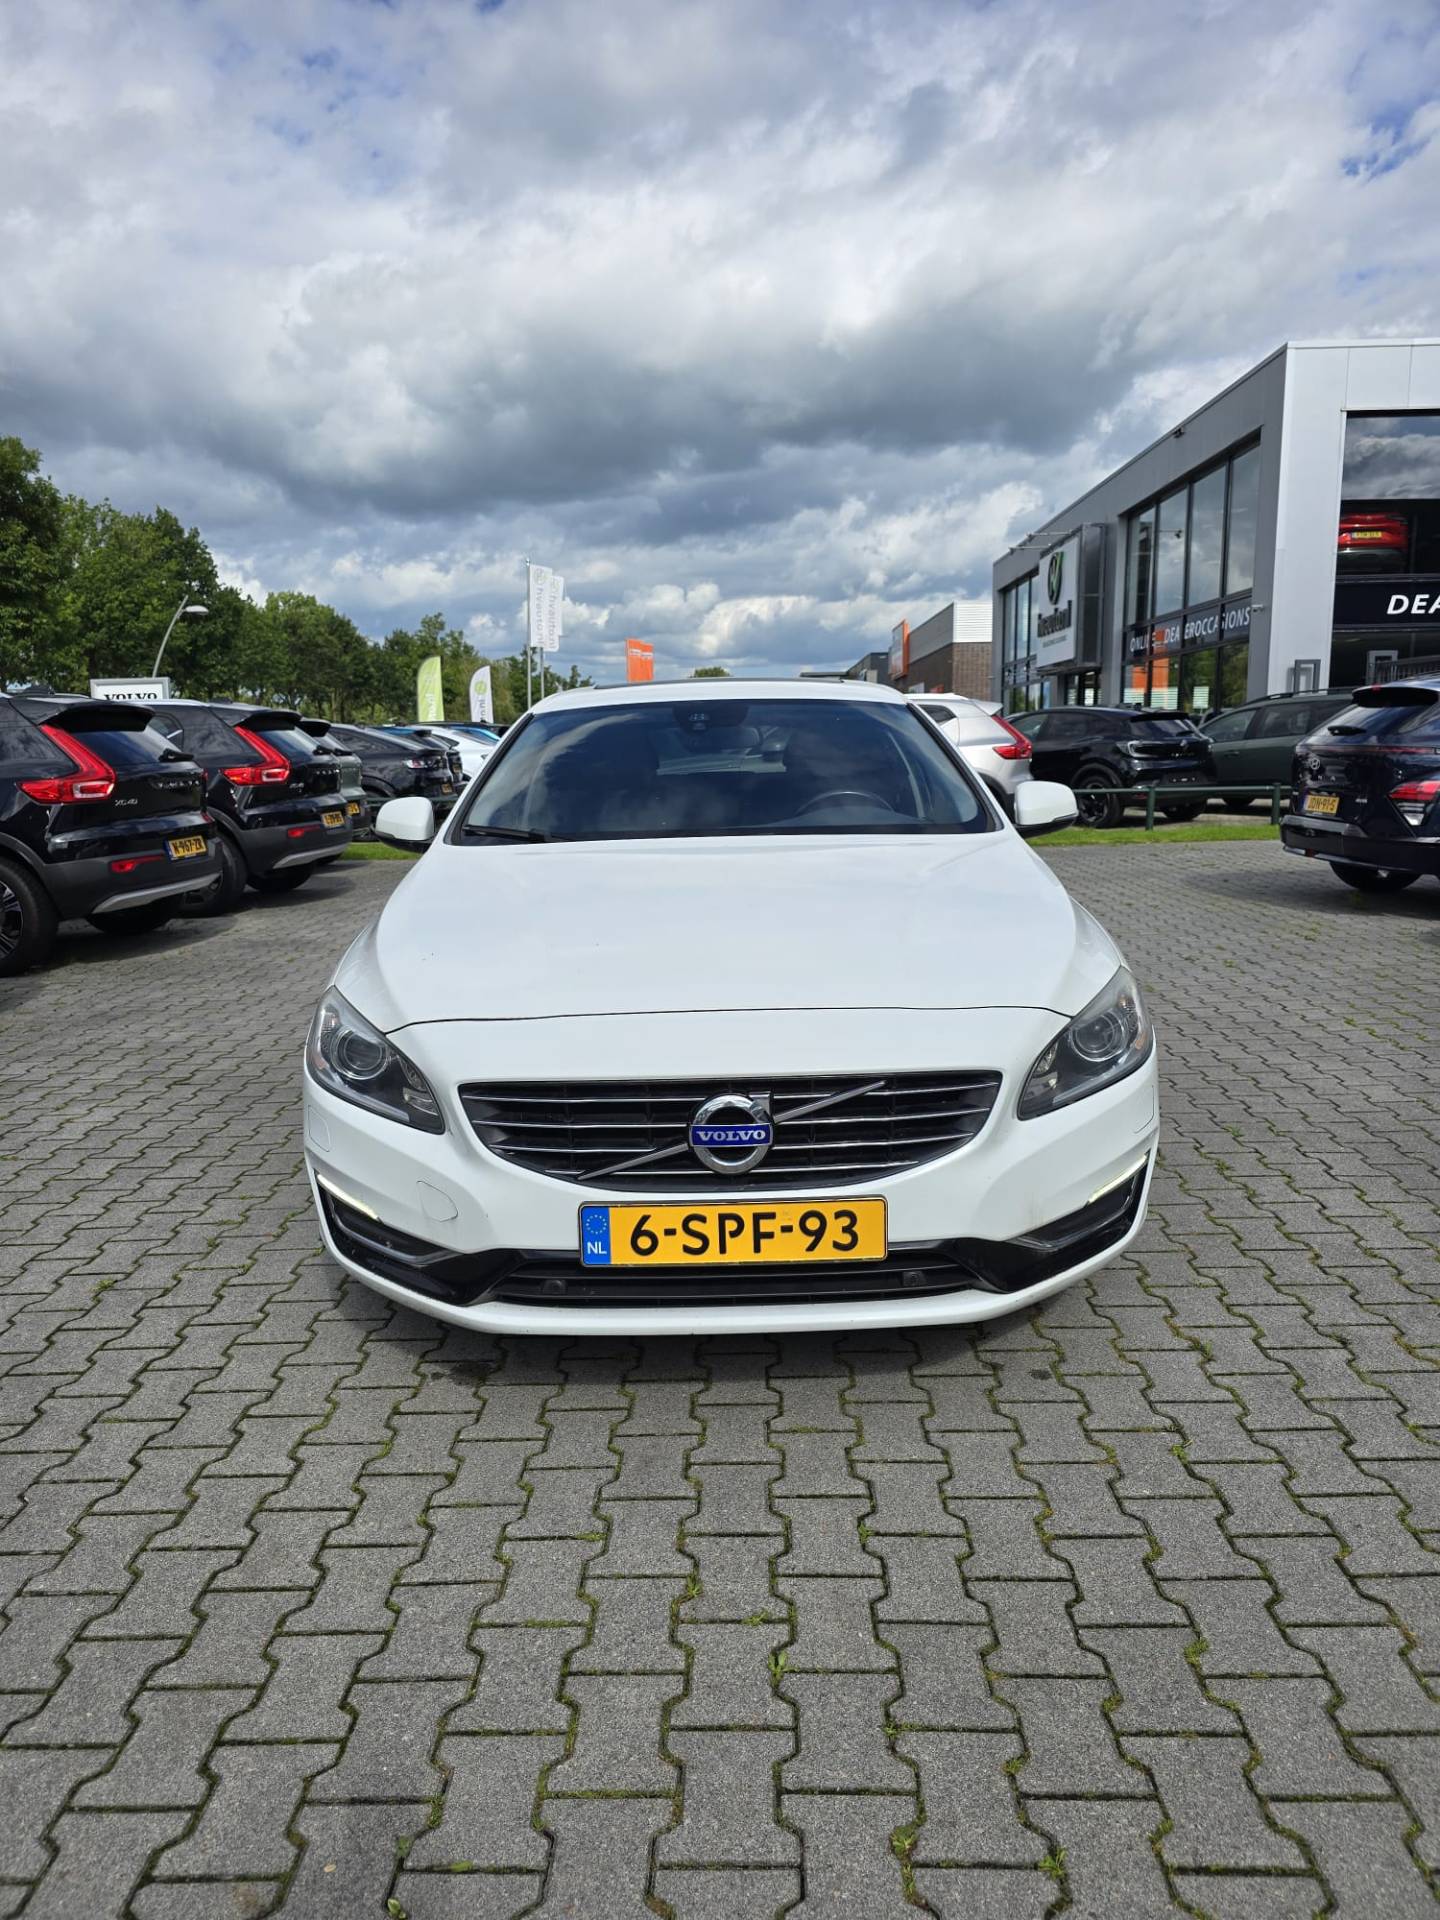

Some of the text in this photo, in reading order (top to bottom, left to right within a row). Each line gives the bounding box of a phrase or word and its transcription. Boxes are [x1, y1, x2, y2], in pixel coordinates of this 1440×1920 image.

[1164, 606, 1251, 644] DEAEROCCAIONS
[695, 1129, 766, 1142] VOLVO
[629, 1208, 859, 1257] 6-SPF-93
[587, 1242, 607, 1255] NL
